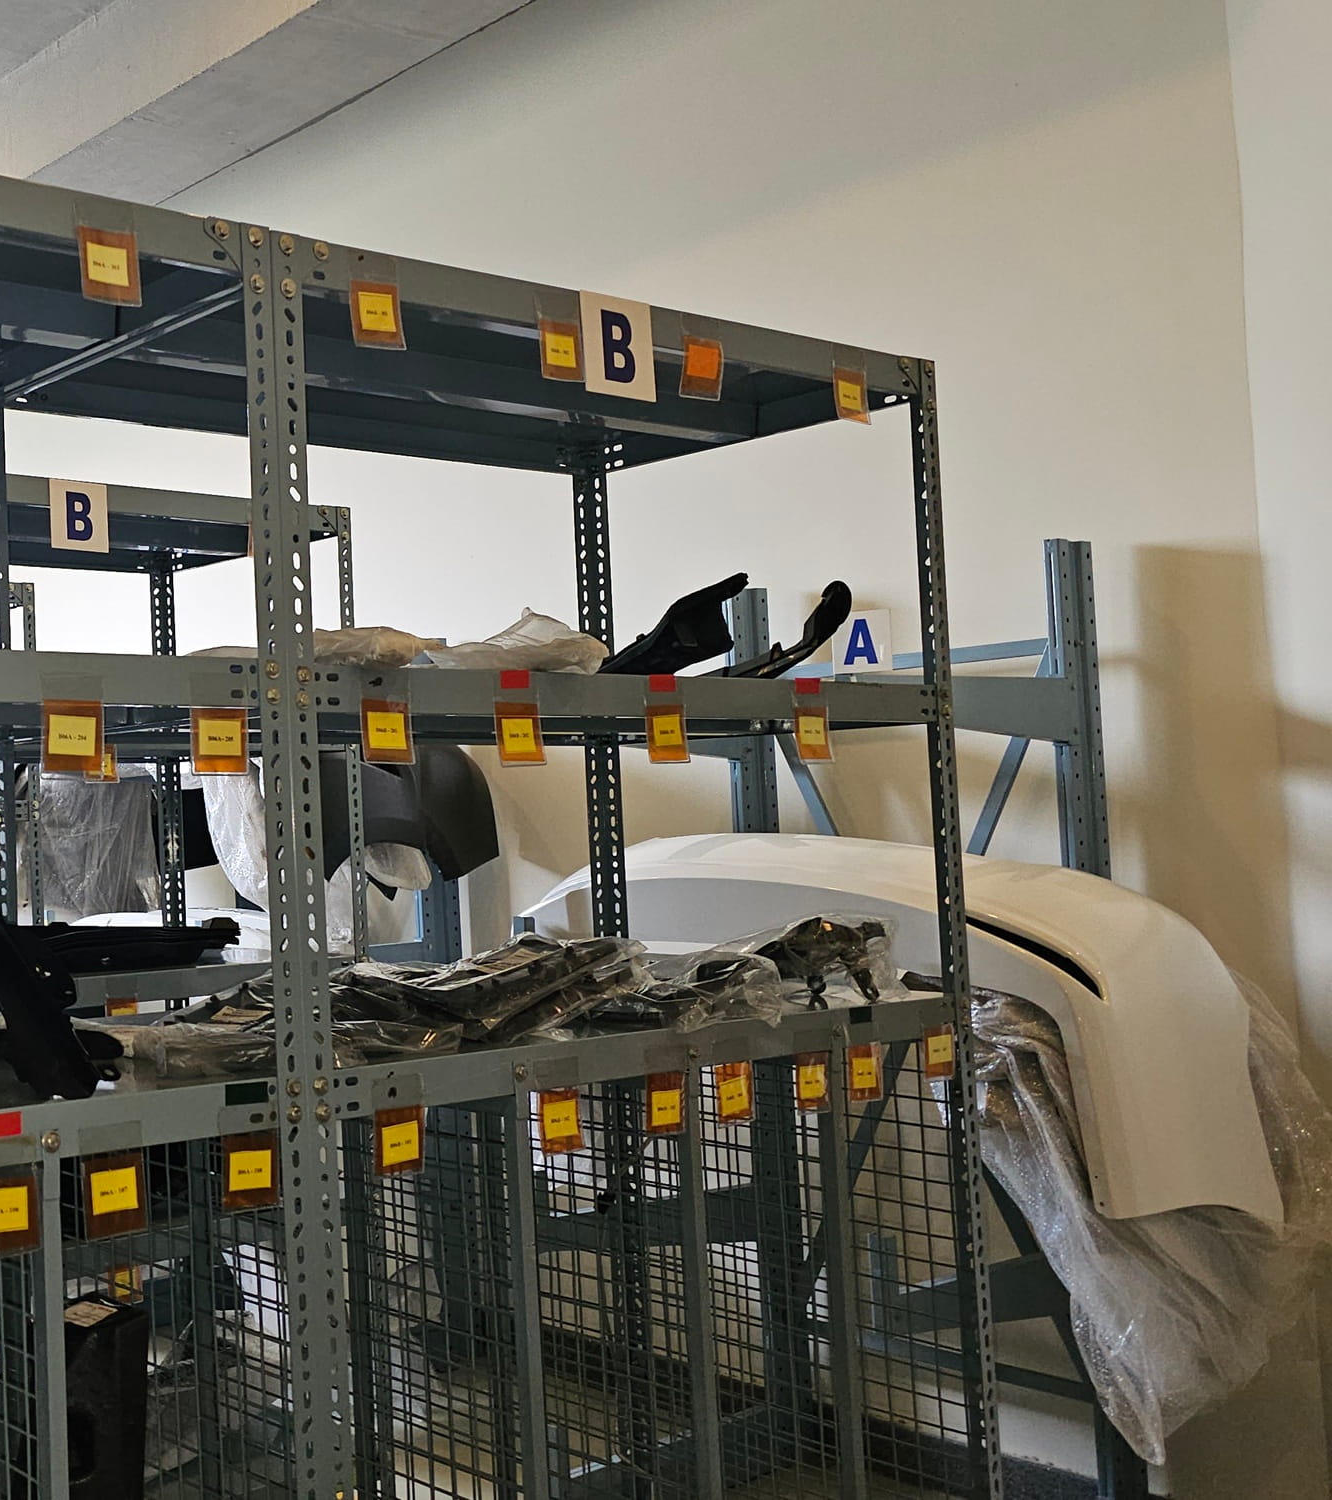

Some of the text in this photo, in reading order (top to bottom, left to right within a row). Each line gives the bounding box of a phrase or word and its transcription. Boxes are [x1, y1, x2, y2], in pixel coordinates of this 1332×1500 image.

[601, 309, 636, 384] B
[65, 490, 93, 541] B
[844, 618, 879, 666] A
